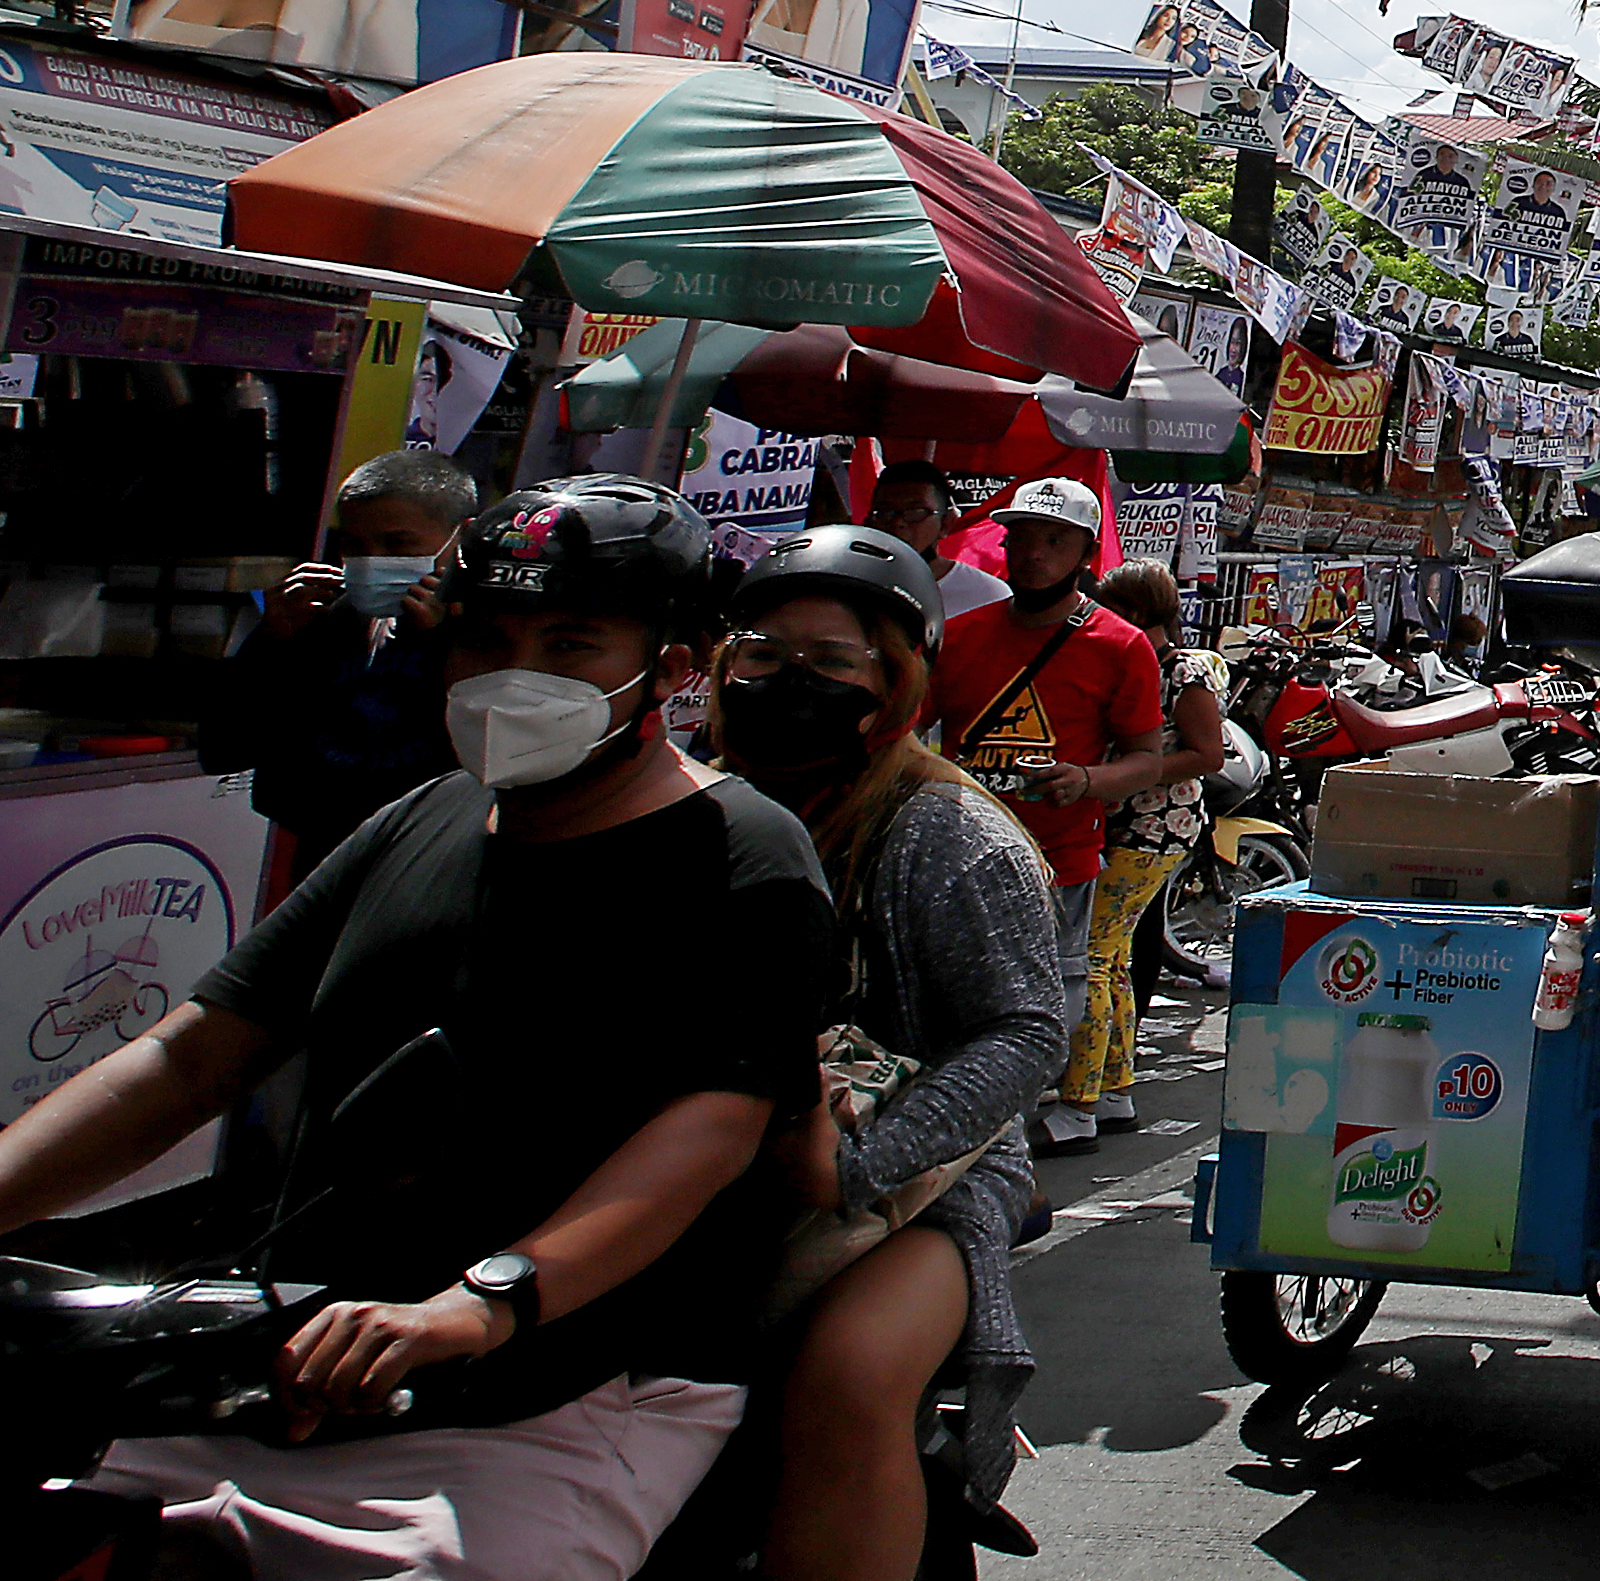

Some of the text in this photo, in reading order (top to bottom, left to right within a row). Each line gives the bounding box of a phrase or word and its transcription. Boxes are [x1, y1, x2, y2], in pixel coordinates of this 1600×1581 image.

[57, 75, 92, 96] MAY
[96, 79, 175, 113] OUTBREAK
[178, 95, 200, 117] NA
[203, 100, 224, 120] NG
[225, 106, 266, 130] POLIO
[269, 116, 288, 134] SA
[41, 242, 180, 278] IMPORTED
[188, 263, 262, 287] FROM
[673, 272, 902, 309] MICROMATIC
[1100, 415, 1218, 442] MICOMATIC
[1397, 941, 1514, 972] Probiotic
[1320, 975, 1378, 1003] DUO ACTIVE
[1415, 969, 1501, 992] Prebiotic
[1413, 987, 1454, 1004] Fiber
[1444, 1100, 1478, 1113] ONLY
[1342, 1157, 1420, 1195] Delight
